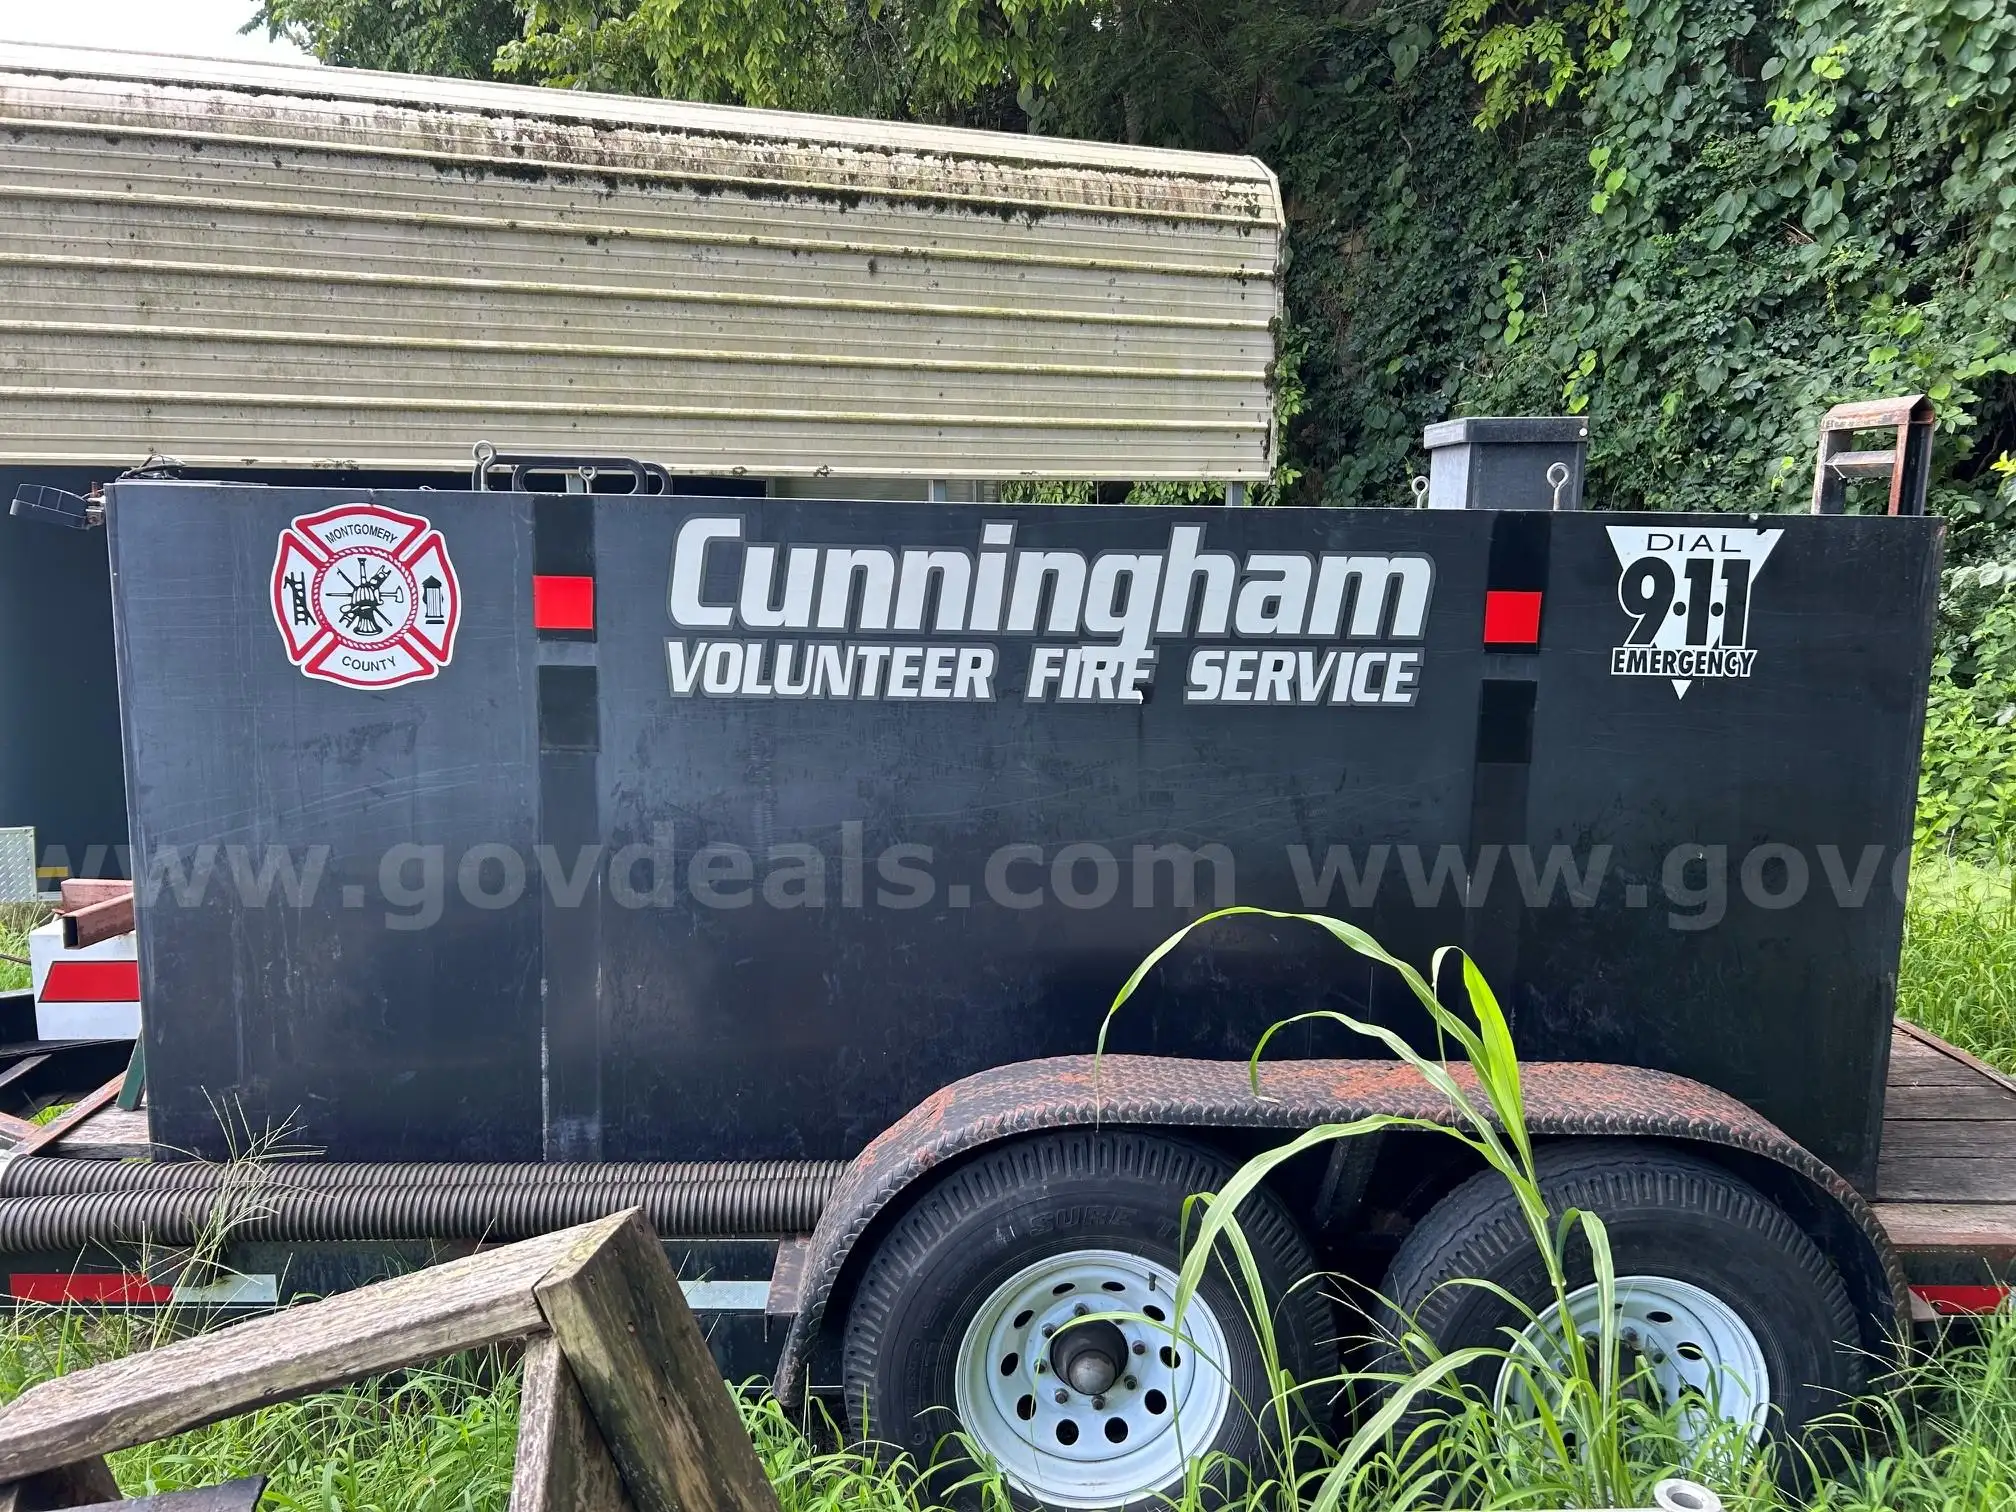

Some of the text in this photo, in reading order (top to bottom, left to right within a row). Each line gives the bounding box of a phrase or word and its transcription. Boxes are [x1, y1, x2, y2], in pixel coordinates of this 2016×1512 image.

[325, 523, 398, 545] MONTGOMERY
[1646, 533, 1742, 553] DIAL
[670, 516, 1432, 662] Cunningham
[341, 655, 397, 672] COUNTY
[667, 640, 1420, 703] VOLUNTEER FIRE SERVICE
[1611, 648, 1757, 677] EMERGENCY
